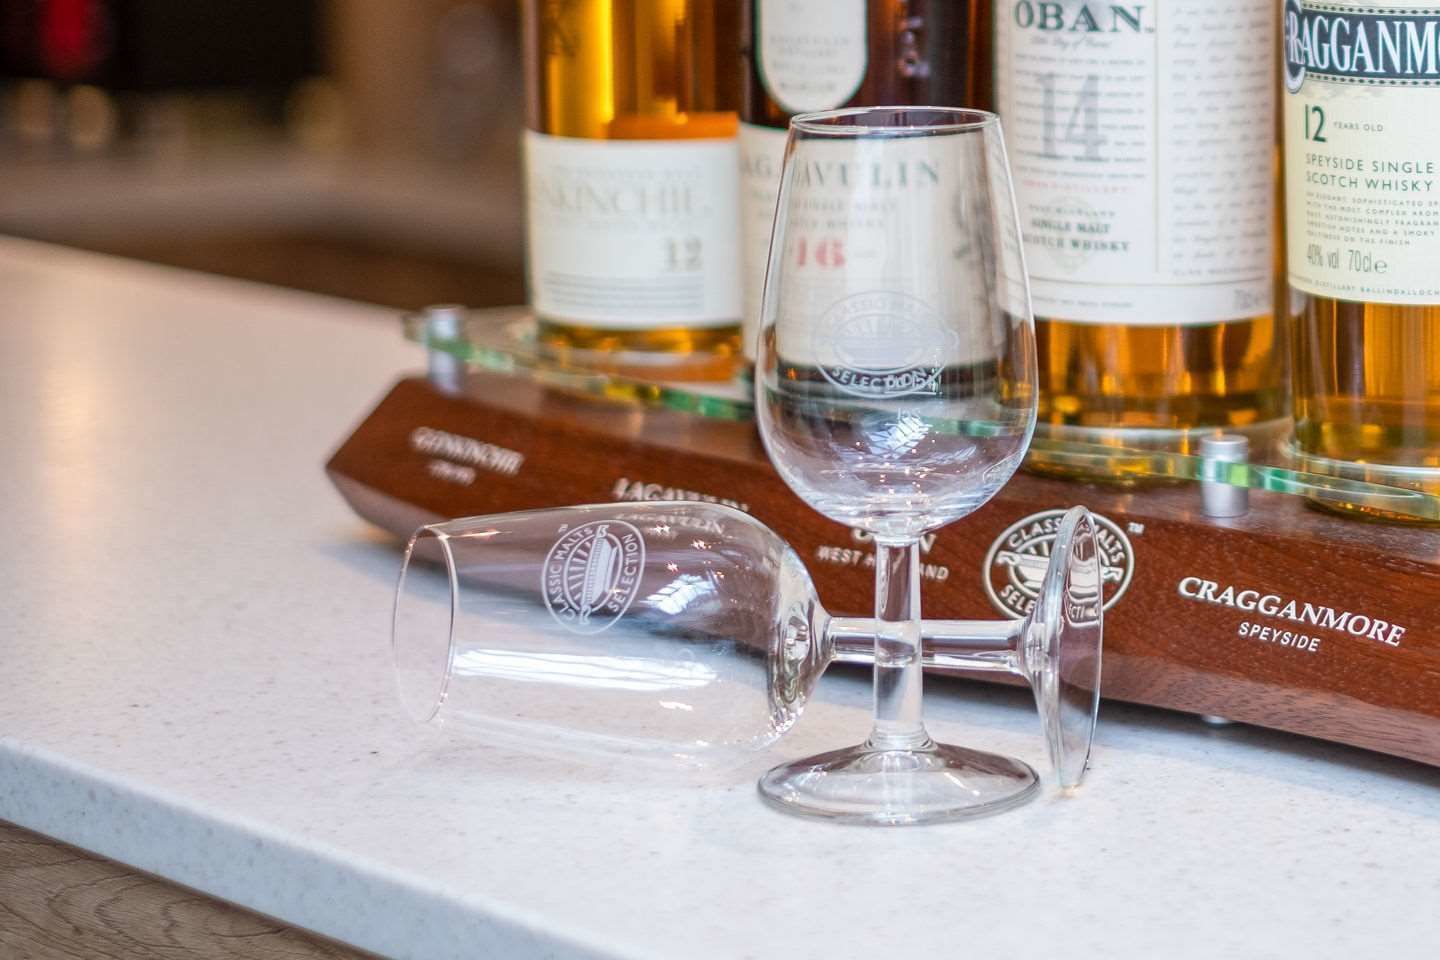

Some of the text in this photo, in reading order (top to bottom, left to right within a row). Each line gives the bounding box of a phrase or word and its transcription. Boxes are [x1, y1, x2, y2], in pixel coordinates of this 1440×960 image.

[1013, 0, 1145, 32] OBAN
[1304, 104, 1327, 143] 12
[1363, 123, 1384, 133] OLD
[1306, 153, 1364, 171] SPEYSIDE
[1372, 161, 1434, 174] SINGLE
[1306, 171, 1434, 192] SCOTCH WHISKY
[1076, 222, 1111, 234] MALT
[663, 238, 703, 272] 12
[796, 236, 847, 267] 16
[1071, 239, 1130, 253] WHISKY
[1327, 247, 1340, 269] vol
[1348, 249, 1372, 273] 70cl
[816, 545, 863, 566] WEST
[548, 527, 594, 621] CLASSIC MALTS
[607, 533, 640, 612] SELECTION
[1177, 575, 1407, 648] CRAGGANMORE
[1237, 621, 1322, 653] SPEYSIDE
